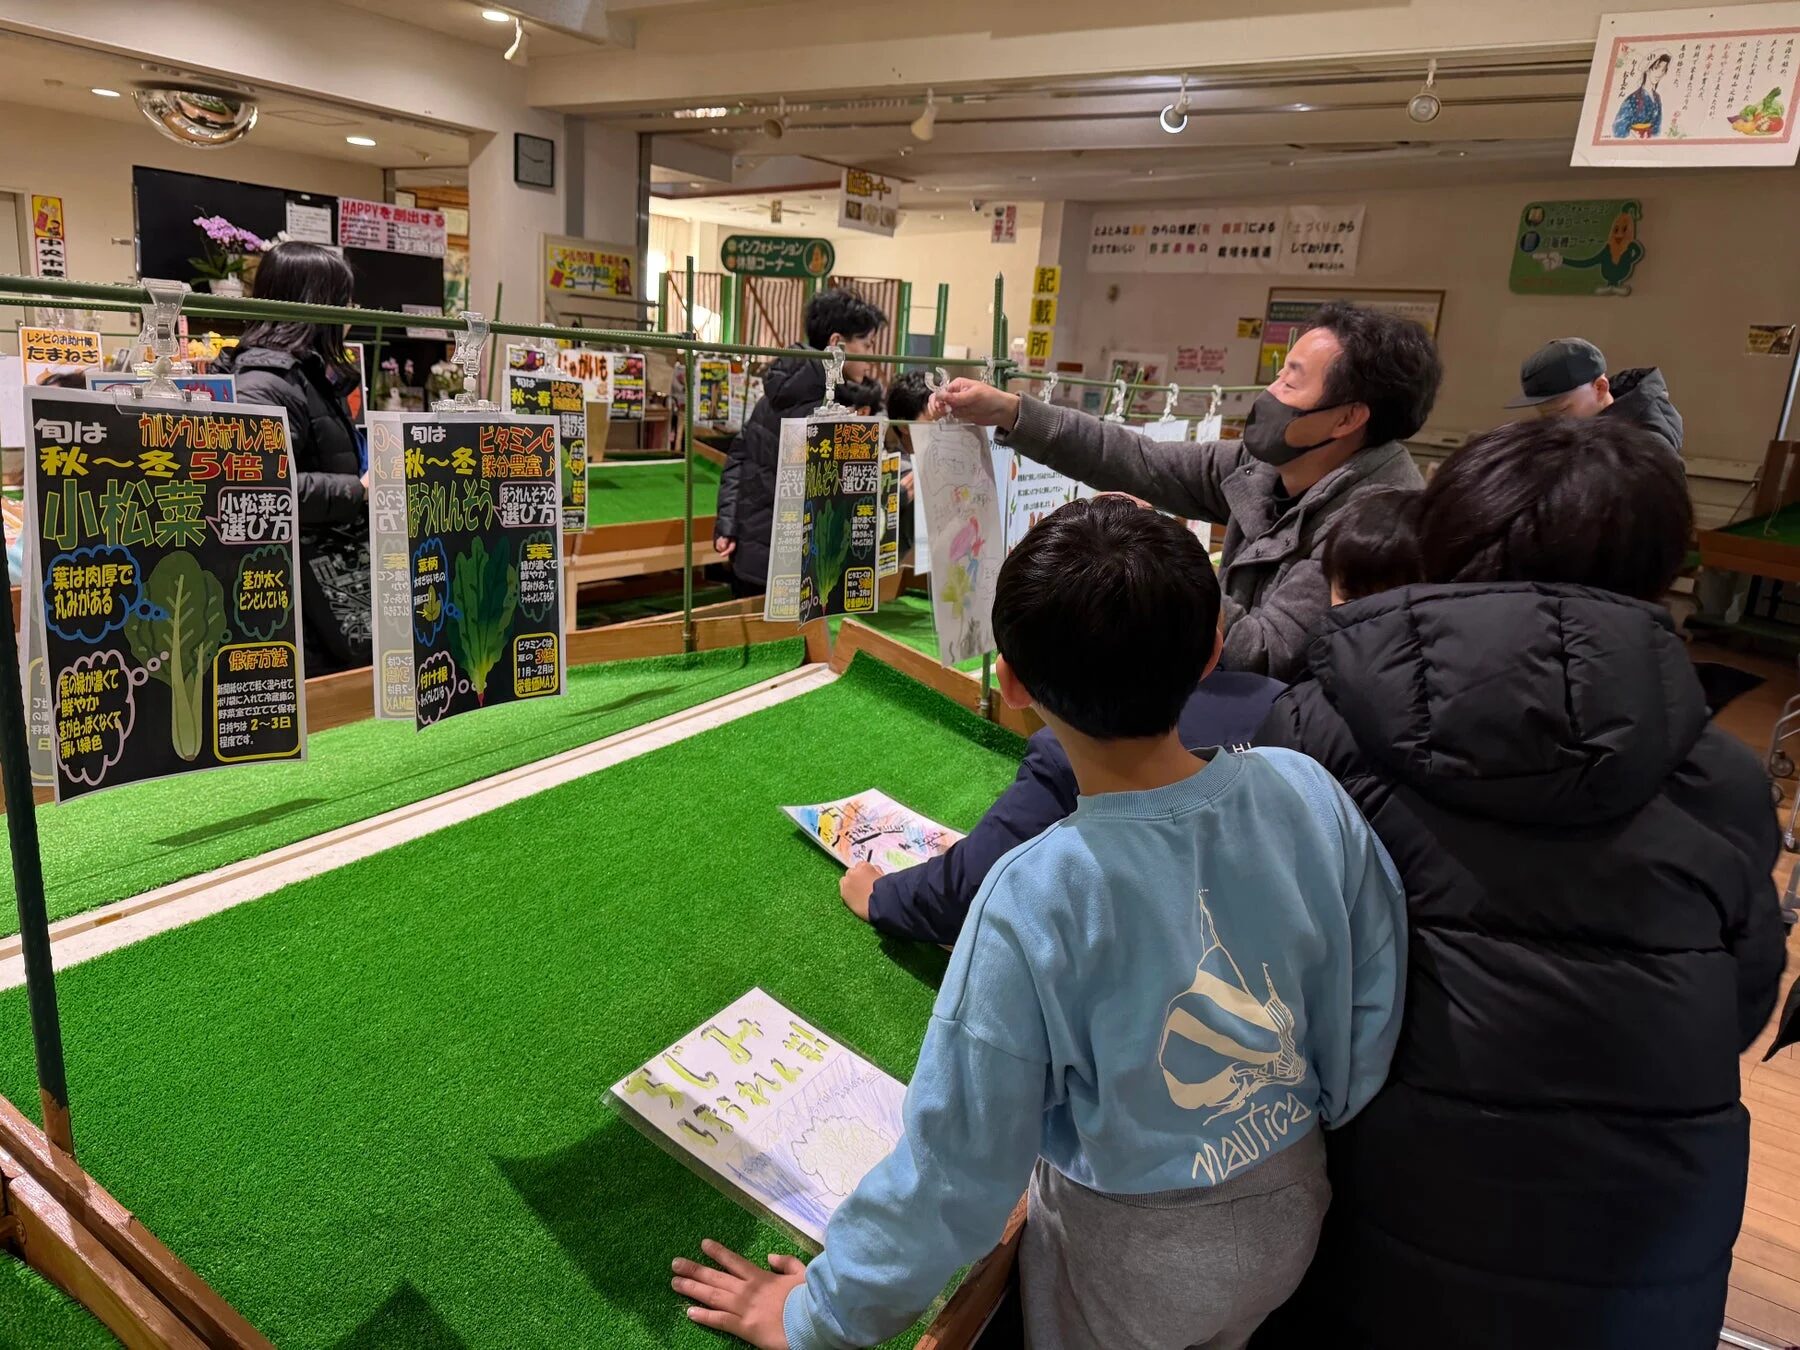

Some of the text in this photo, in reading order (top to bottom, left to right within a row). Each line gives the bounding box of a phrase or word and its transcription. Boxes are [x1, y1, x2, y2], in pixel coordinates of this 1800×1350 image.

[737, 240, 804, 256] インフォメーション
[26, 346, 99, 364] たまねぎ
[34, 418, 108, 445] 旬は
[138, 413, 288, 455] カルシウムはホウレン草の
[410, 425, 447, 445] 旬は
[479, 425, 556, 454] ビタミンC
[833, 423, 879, 444] ビタミンC
[843, 476, 878, 492] 選び方
[220, 493, 293, 515] 小松菜の
[501, 486, 556, 504] ほうれんそうの
[42, 478, 208, 551] 小松菜
[407, 478, 494, 539] ほうれんそう
[501, 502, 556, 525] 選び方
[220, 514, 293, 543] 選び方
[526, 543, 553, 560] 葉
[520, 559, 559, 572] 緑が濃くて
[520, 570, 548, 581] 鮮やか
[52, 564, 134, 591] 葉は肉厚で
[242, 570, 285, 591] 茎が太く
[54, 588, 114, 620] 丸みがある
[517, 637, 553, 652] ビタミンCは
[228, 648, 289, 672] 保存方法
[60, 668, 120, 698] 葉の緑が濃くて
[420, 665, 448, 691] 付け根
[517, 674, 556, 695] 栄養価MAX
[60, 693, 100, 717] 鮮やか
[217, 702, 297, 720] 野菜室で立てて保存
[218, 720, 248, 736] 日持ちは
[59, 734, 104, 760] 薄い緑色
[218, 732, 256, 749] 程度です。
